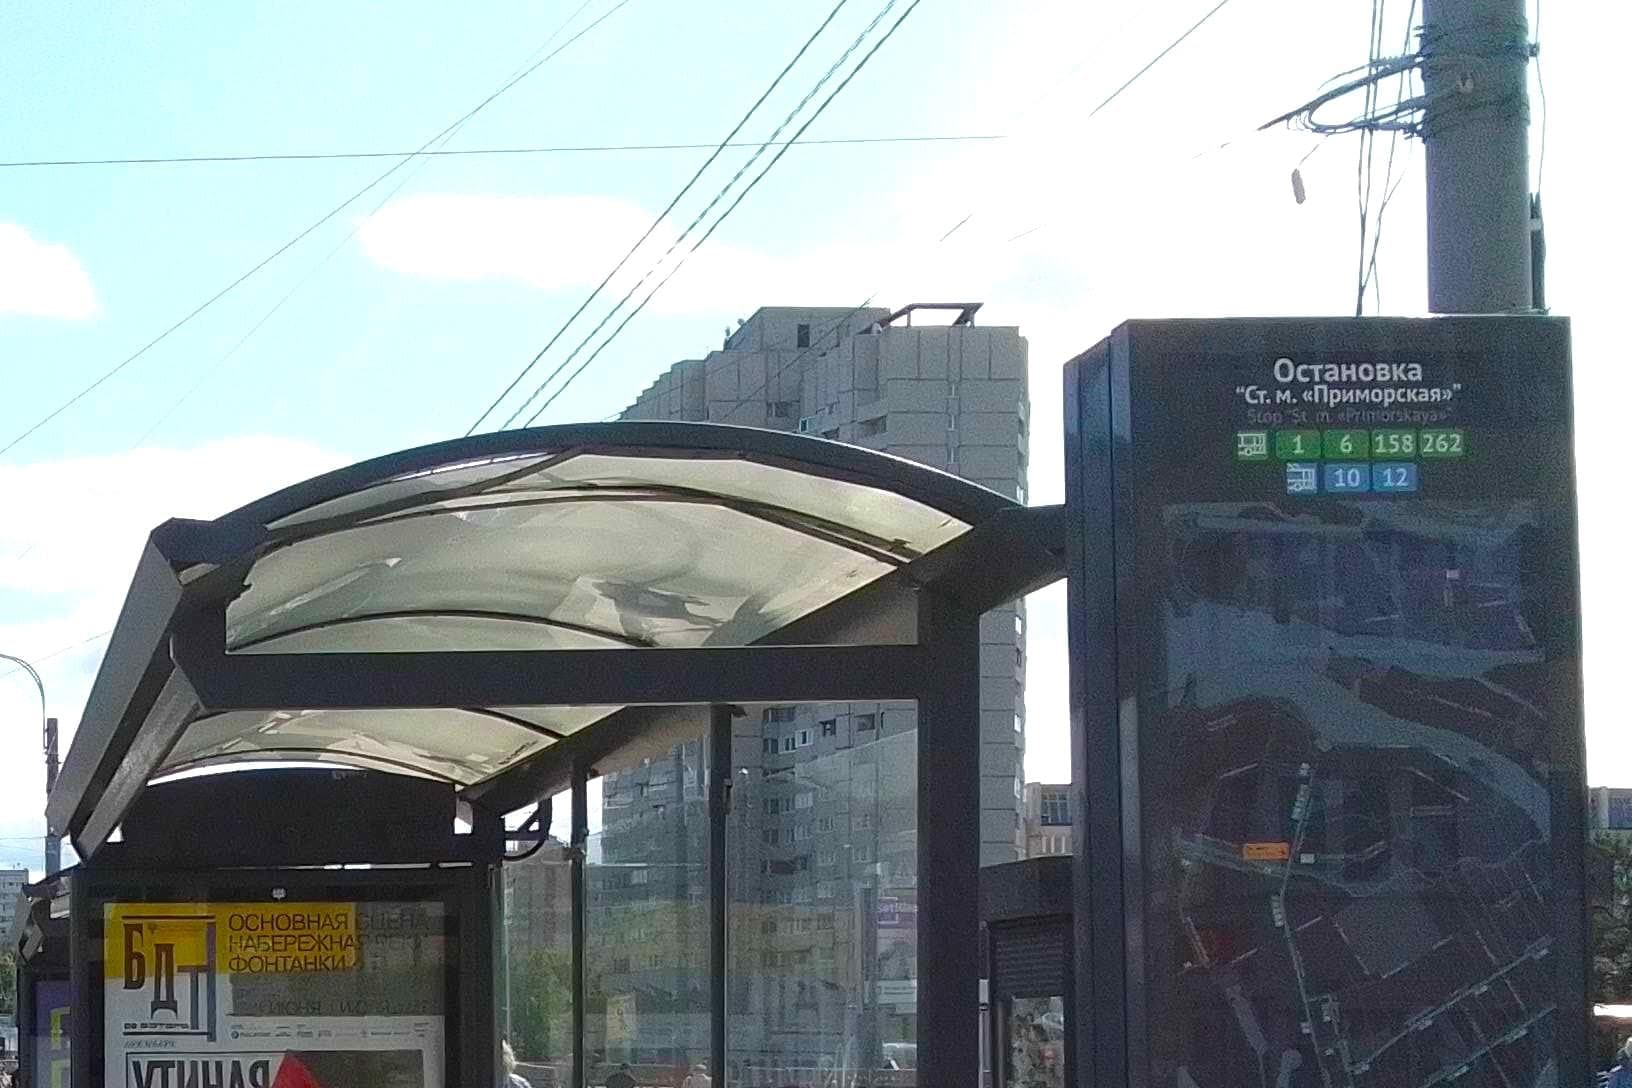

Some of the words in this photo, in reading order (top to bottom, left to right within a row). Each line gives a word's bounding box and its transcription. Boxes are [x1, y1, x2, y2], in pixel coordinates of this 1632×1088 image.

[1273, 358, 1423, 383] Остановка
[1276, 389, 1298, 404] м.
[1292, 435, 1305, 454] 1
[1340, 434, 1353, 454] 6
[1375, 434, 1415, 454] 158
[1422, 433, 1463, 453] 262
[1334, 469, 1362, 488] 10
[1382, 469, 1409, 488] 12
[228, 913, 349, 932] ОСНОВНАЯ
[228, 934, 368, 953] НАБЕРЕЖНАЯ
